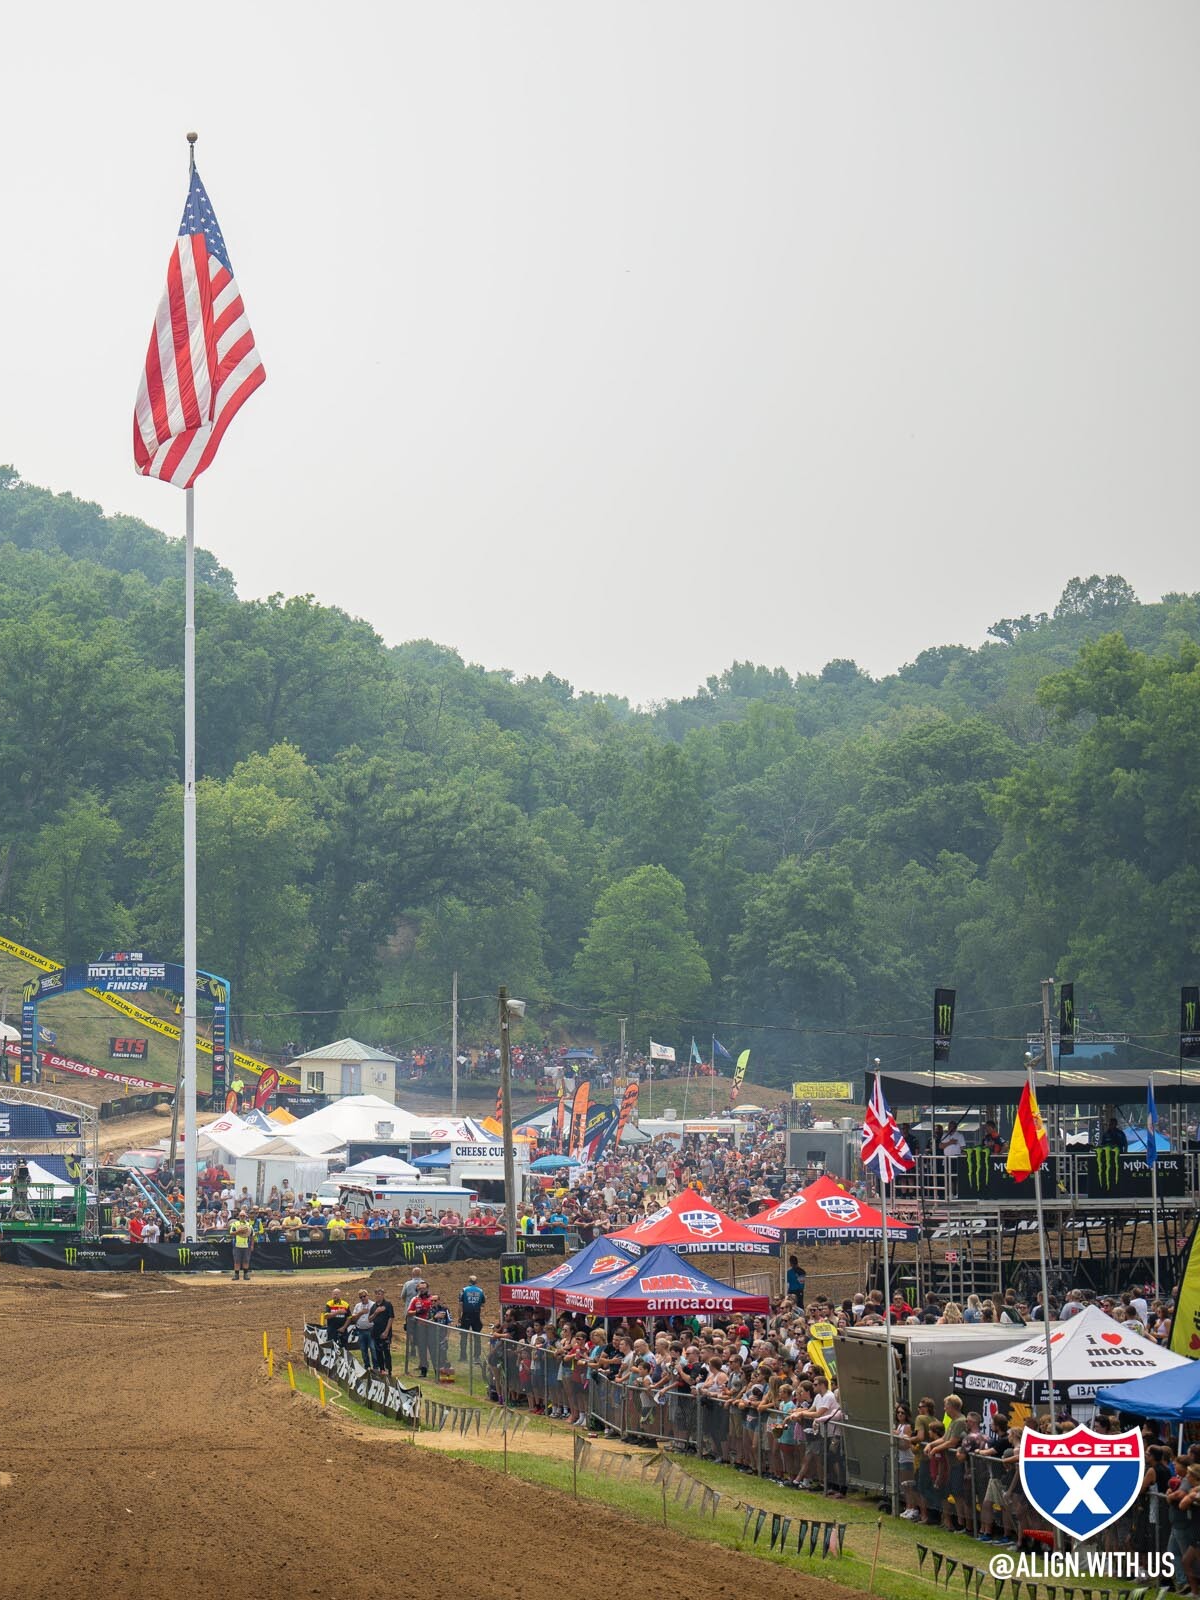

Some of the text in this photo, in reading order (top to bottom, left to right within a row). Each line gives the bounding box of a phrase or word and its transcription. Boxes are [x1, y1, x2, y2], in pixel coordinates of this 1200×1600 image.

[19, 949, 48, 966] SUZUKI
[88, 967, 165, 977] MOTOCROSS
[106, 981, 148, 990] FINISH
[106, 994, 132, 1014] SUZUKI
[134, 1011, 163, 1028] SUZUKI
[115, 1038, 146, 1051] ETS
[50, 1056, 100, 1077] GASGAS
[455, 1146, 517, 1157] CHEESE CURS
[511, 1288, 594, 1312] armca.org armca.org
[647, 1297, 733, 1312] armca.org
[1086, 1334, 1096, 1345] i
[1086, 1346, 1145, 1357] moto
[1089, 1357, 1157, 1368] moms
